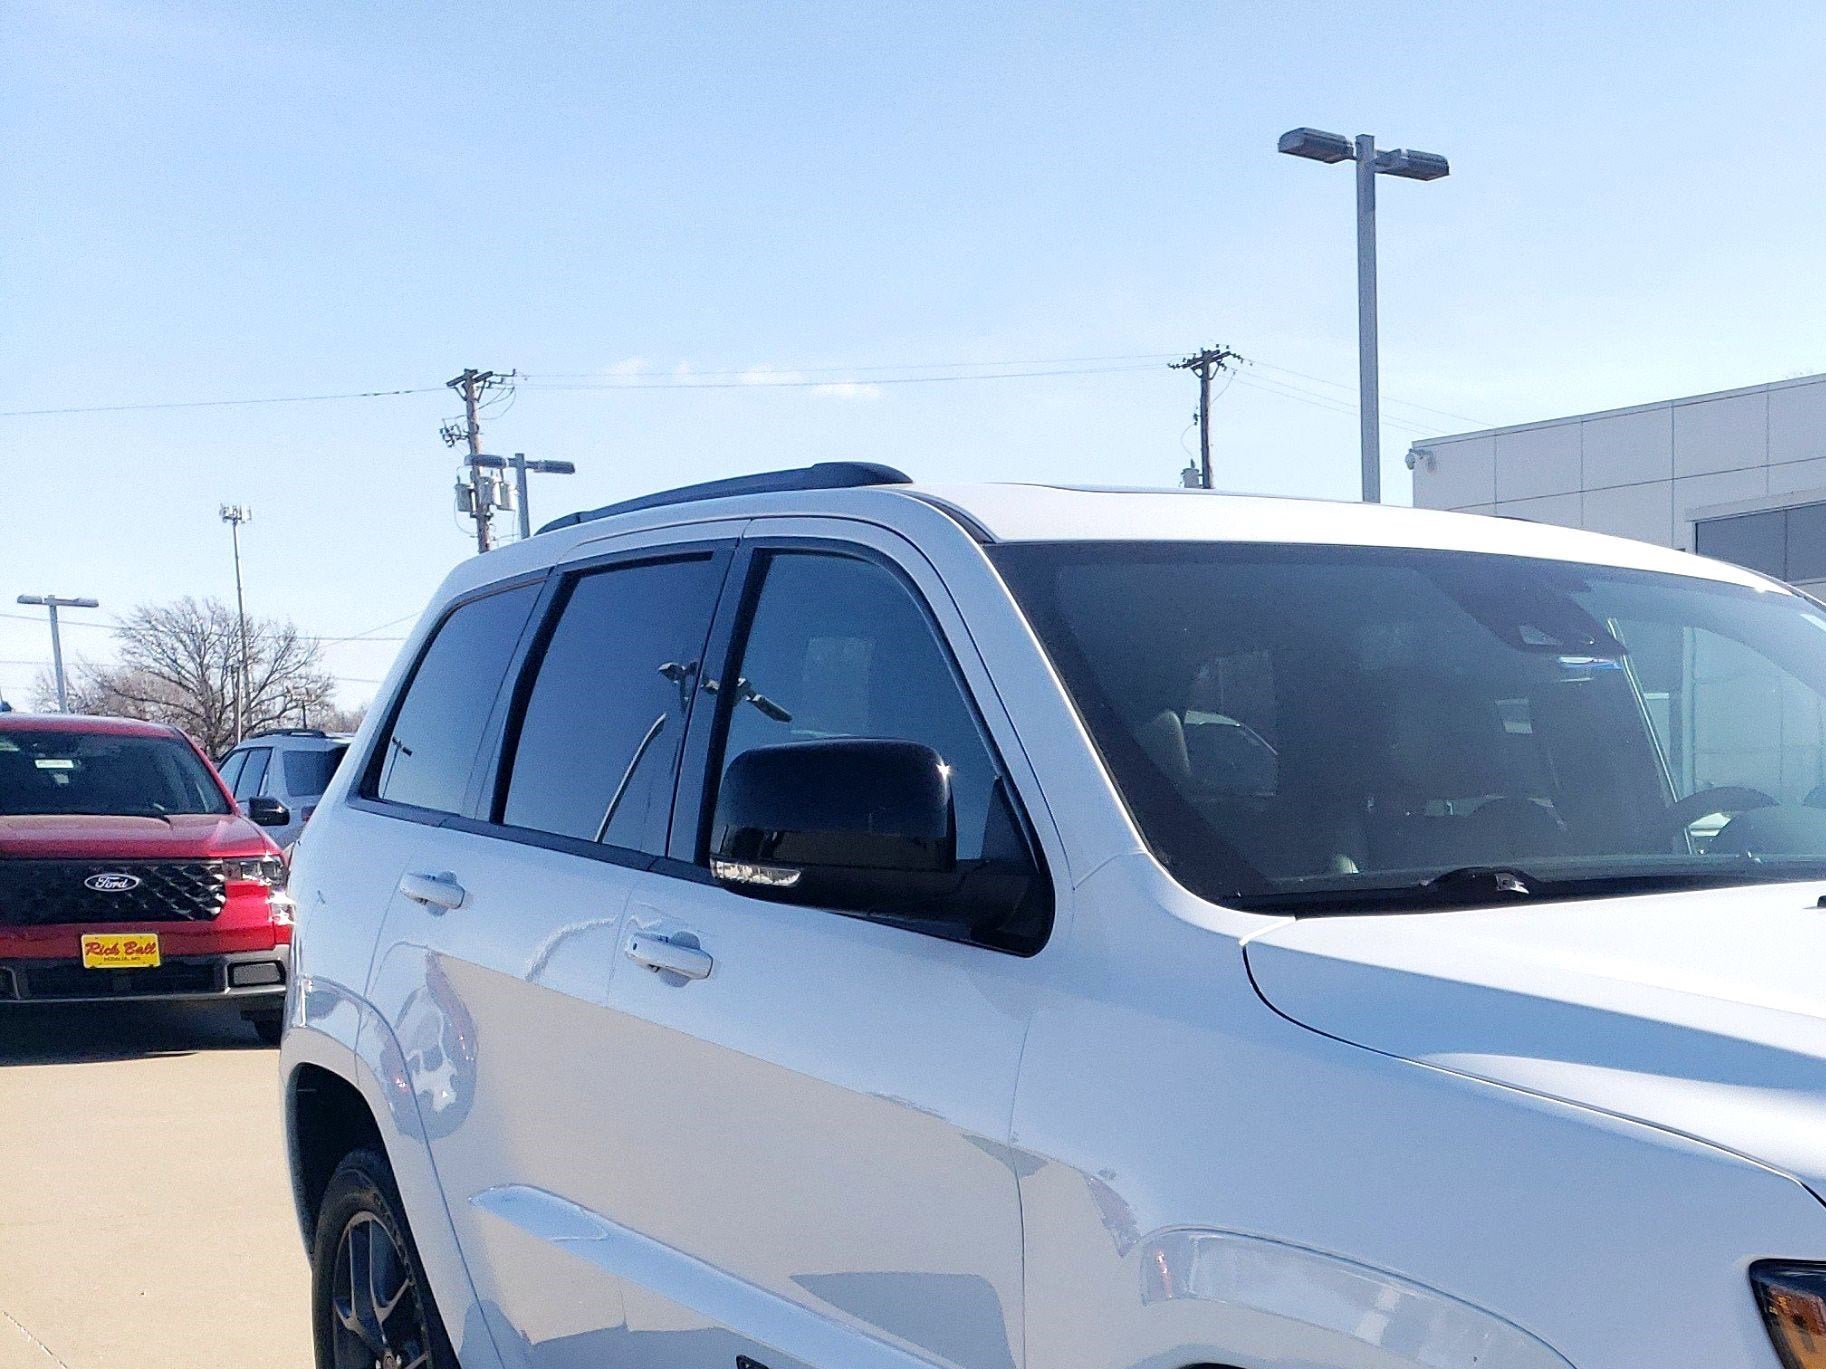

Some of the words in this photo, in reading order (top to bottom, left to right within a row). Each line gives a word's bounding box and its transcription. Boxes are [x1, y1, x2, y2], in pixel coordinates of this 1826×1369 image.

[95, 876, 128, 889] Ford
[85, 941, 120, 956] Rick
[124, 941, 156, 955] Ball
